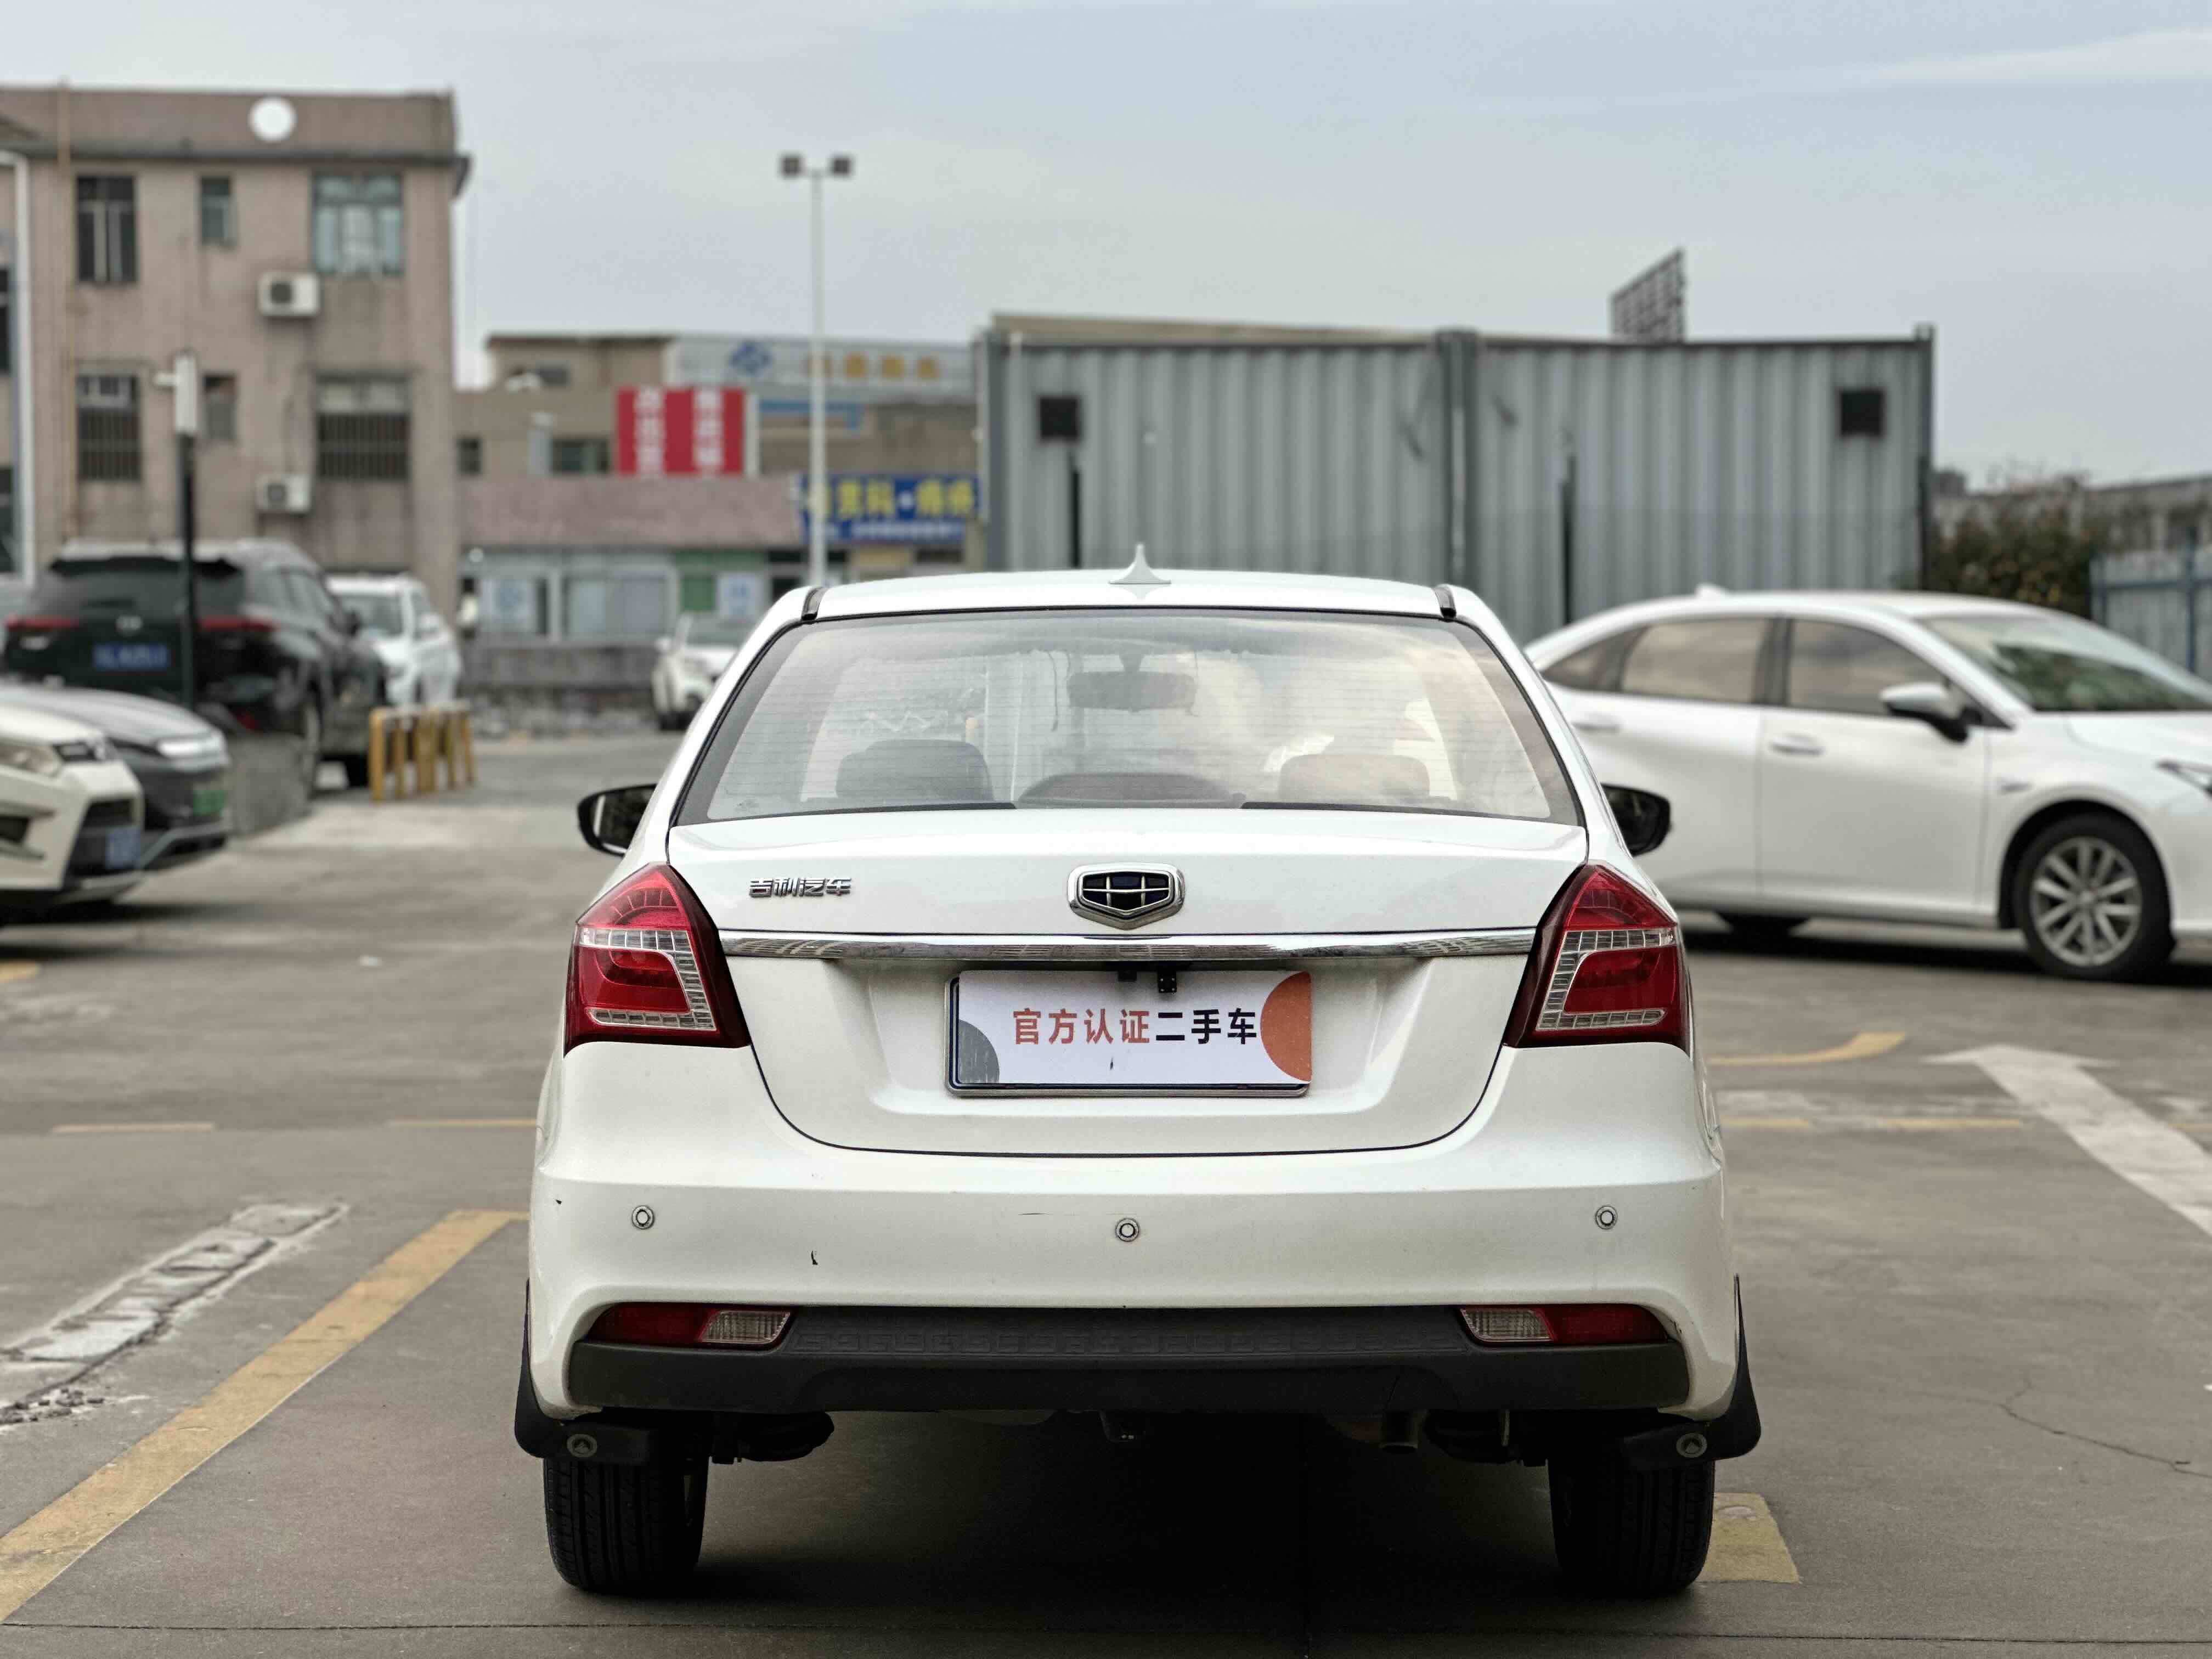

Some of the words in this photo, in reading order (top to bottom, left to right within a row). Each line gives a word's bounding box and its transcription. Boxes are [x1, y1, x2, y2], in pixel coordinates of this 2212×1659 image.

[749, 877, 851, 898] 吉利汽车
[1013, 1007, 1257, 1045] 官方认证二手车
